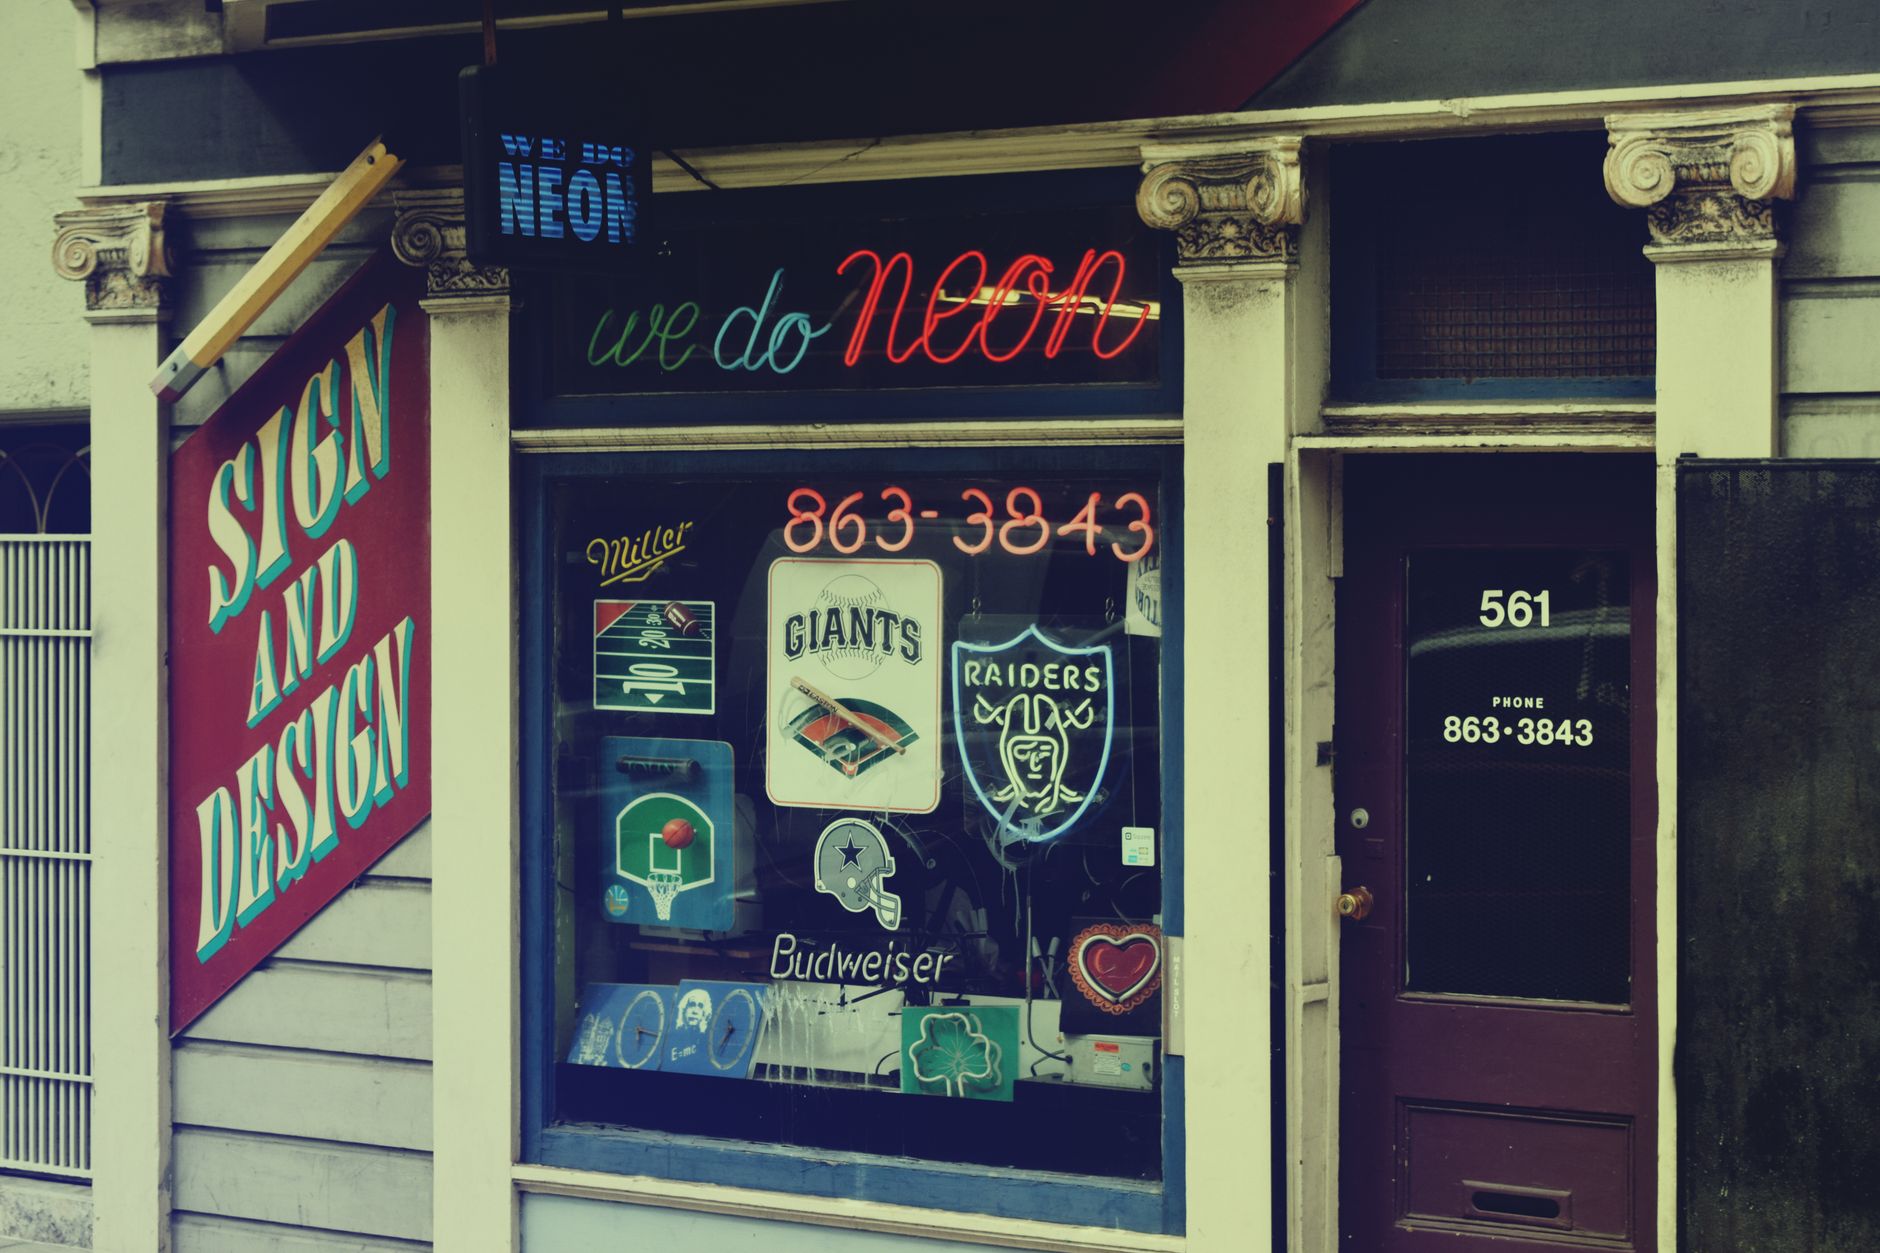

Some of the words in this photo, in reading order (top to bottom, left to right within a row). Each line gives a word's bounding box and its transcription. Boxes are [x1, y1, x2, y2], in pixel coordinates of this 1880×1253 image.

[501, 134, 566, 161] WE
[581, 143, 636, 168] DO
[498, 162, 637, 245] NEON
[587, 302, 698, 371] we
[713, 267, 832, 374] do
[837, 249, 1151, 366] neon
[207, 302, 397, 635] SIGN
[586, 520, 694, 578] Miller
[783, 486, 1154, 563] 863-3843
[246, 538, 358, 729] AND
[782, 602, 923, 666] GIANTS
[1479, 589, 1550, 627] 561
[622, 663, 686, 696] 10
[963, 660, 1103, 693] RAIDERS
[1492, 696, 1545, 709] PHONE
[196, 616, 415, 964] DESIGN
[770, 933, 954, 983] Budweiser
